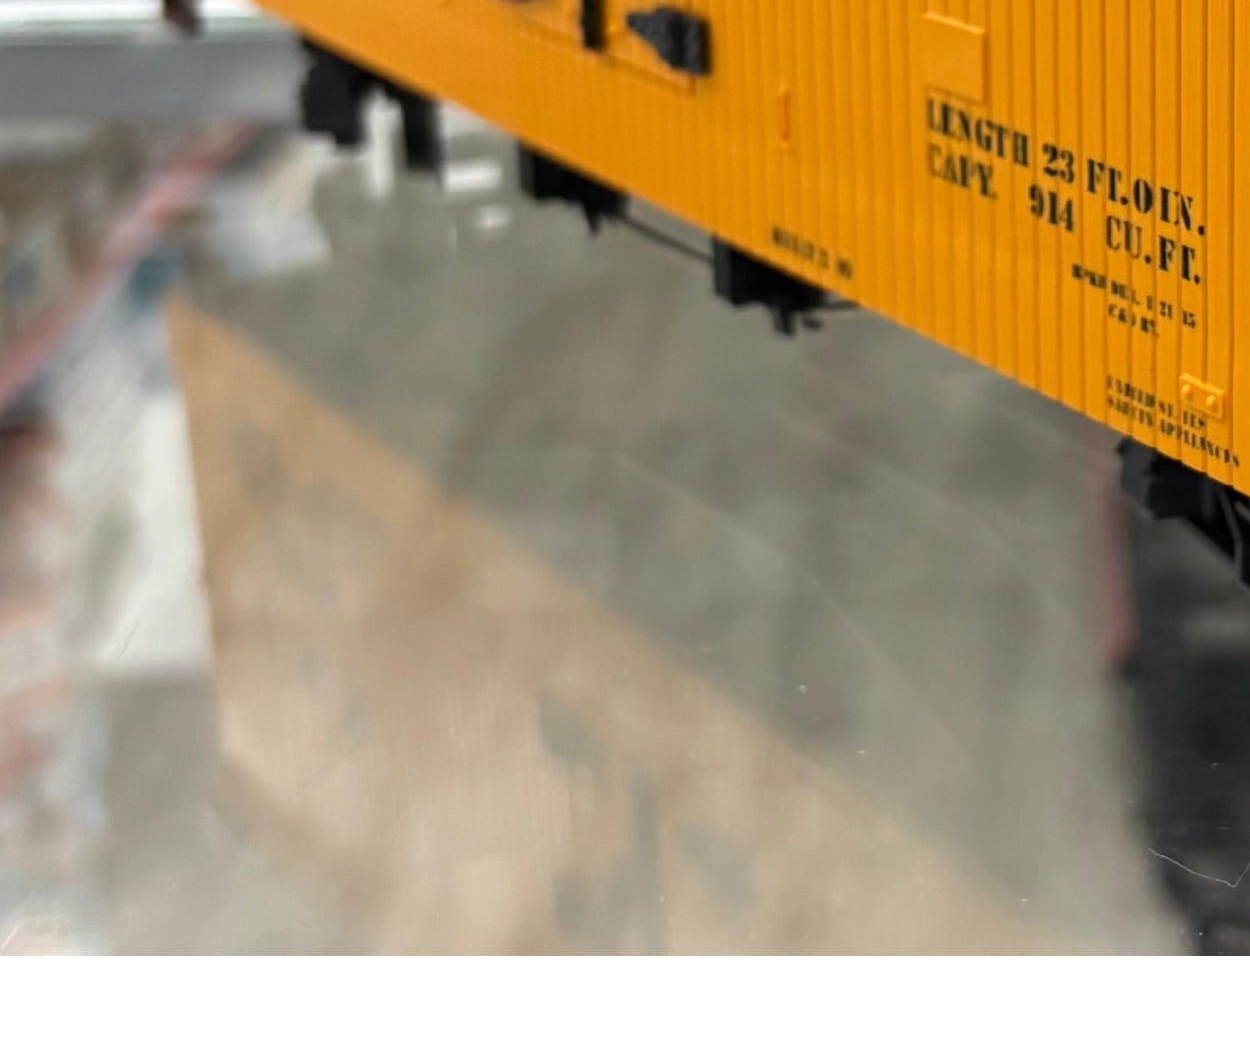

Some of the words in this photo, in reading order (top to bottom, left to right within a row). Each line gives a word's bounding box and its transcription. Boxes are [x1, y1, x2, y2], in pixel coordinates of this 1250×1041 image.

[926, 98, 1030, 168] LENGTH
[1042, 143, 1075, 185] 23
[1028, 183, 1075, 233] 914
